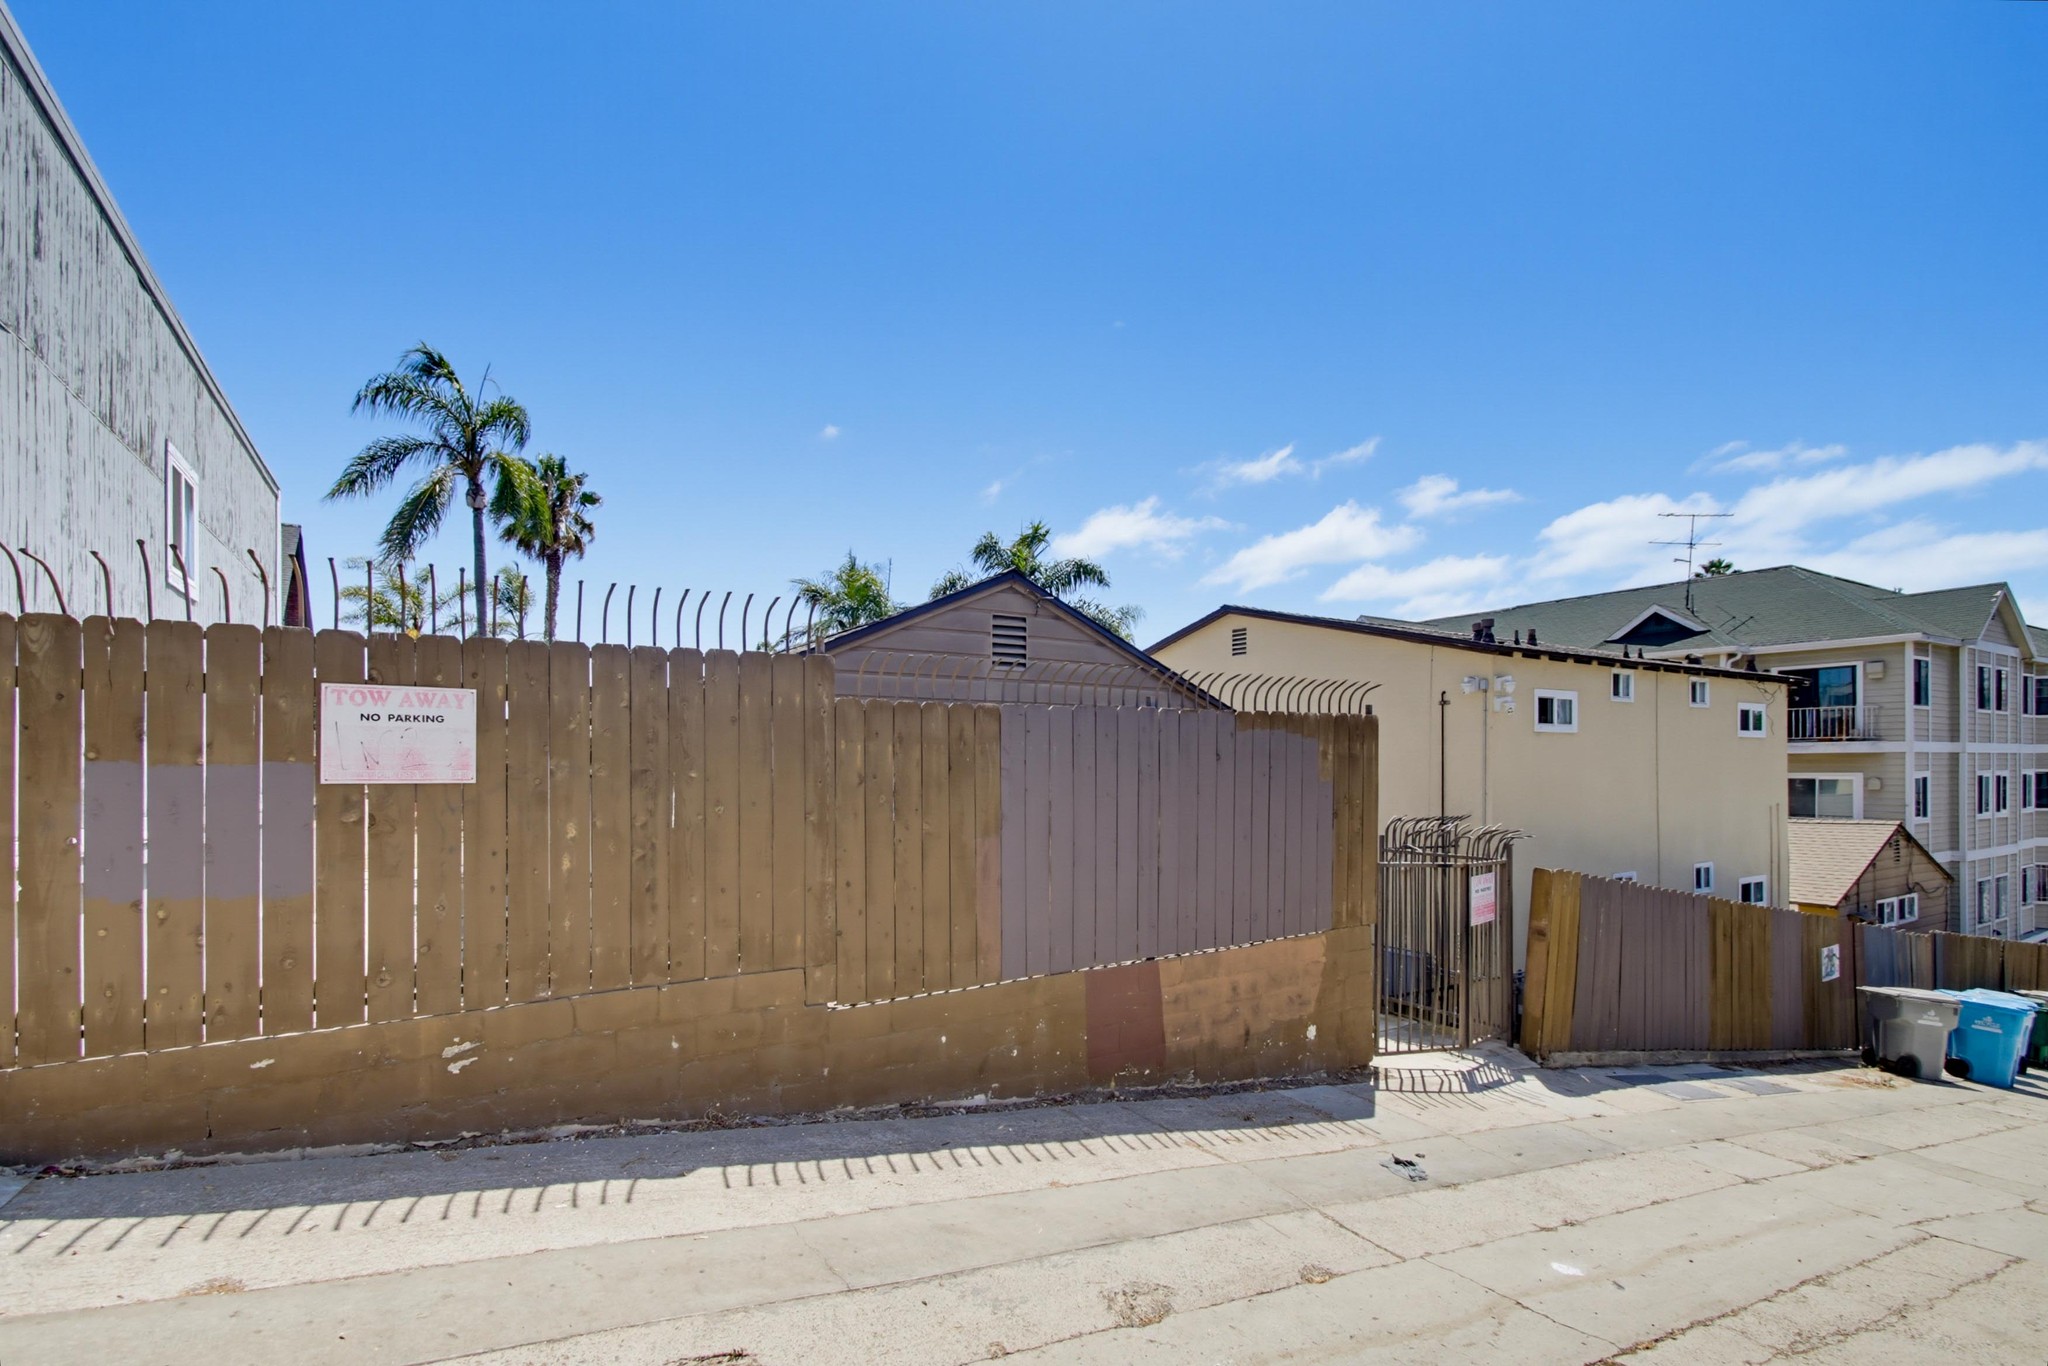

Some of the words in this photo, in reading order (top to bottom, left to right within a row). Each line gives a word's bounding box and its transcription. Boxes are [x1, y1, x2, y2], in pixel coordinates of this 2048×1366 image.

[332, 688, 391, 707] TOW
[399, 692, 466, 709] AWAY
[360, 713, 381, 722] NO
[388, 713, 445, 723] PARKING
